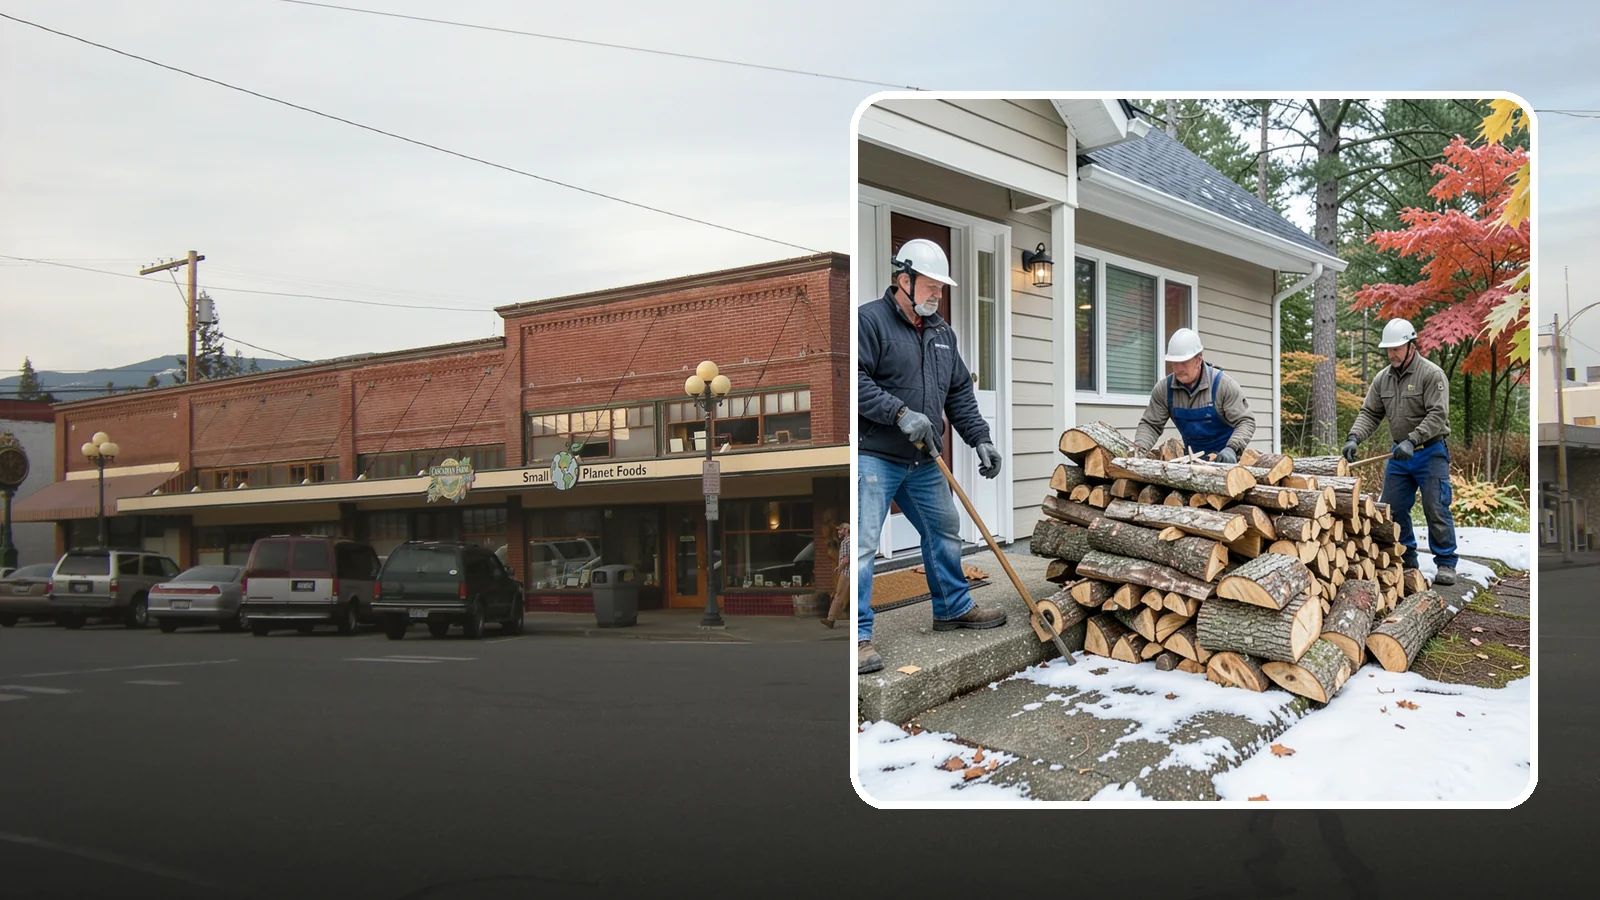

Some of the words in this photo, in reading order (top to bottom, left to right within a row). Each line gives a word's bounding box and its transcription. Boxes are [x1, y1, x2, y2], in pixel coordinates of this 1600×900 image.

[523, 471, 549, 483] Small
[583, 467, 614, 479] Planet
[617, 464, 647, 477] Foods
